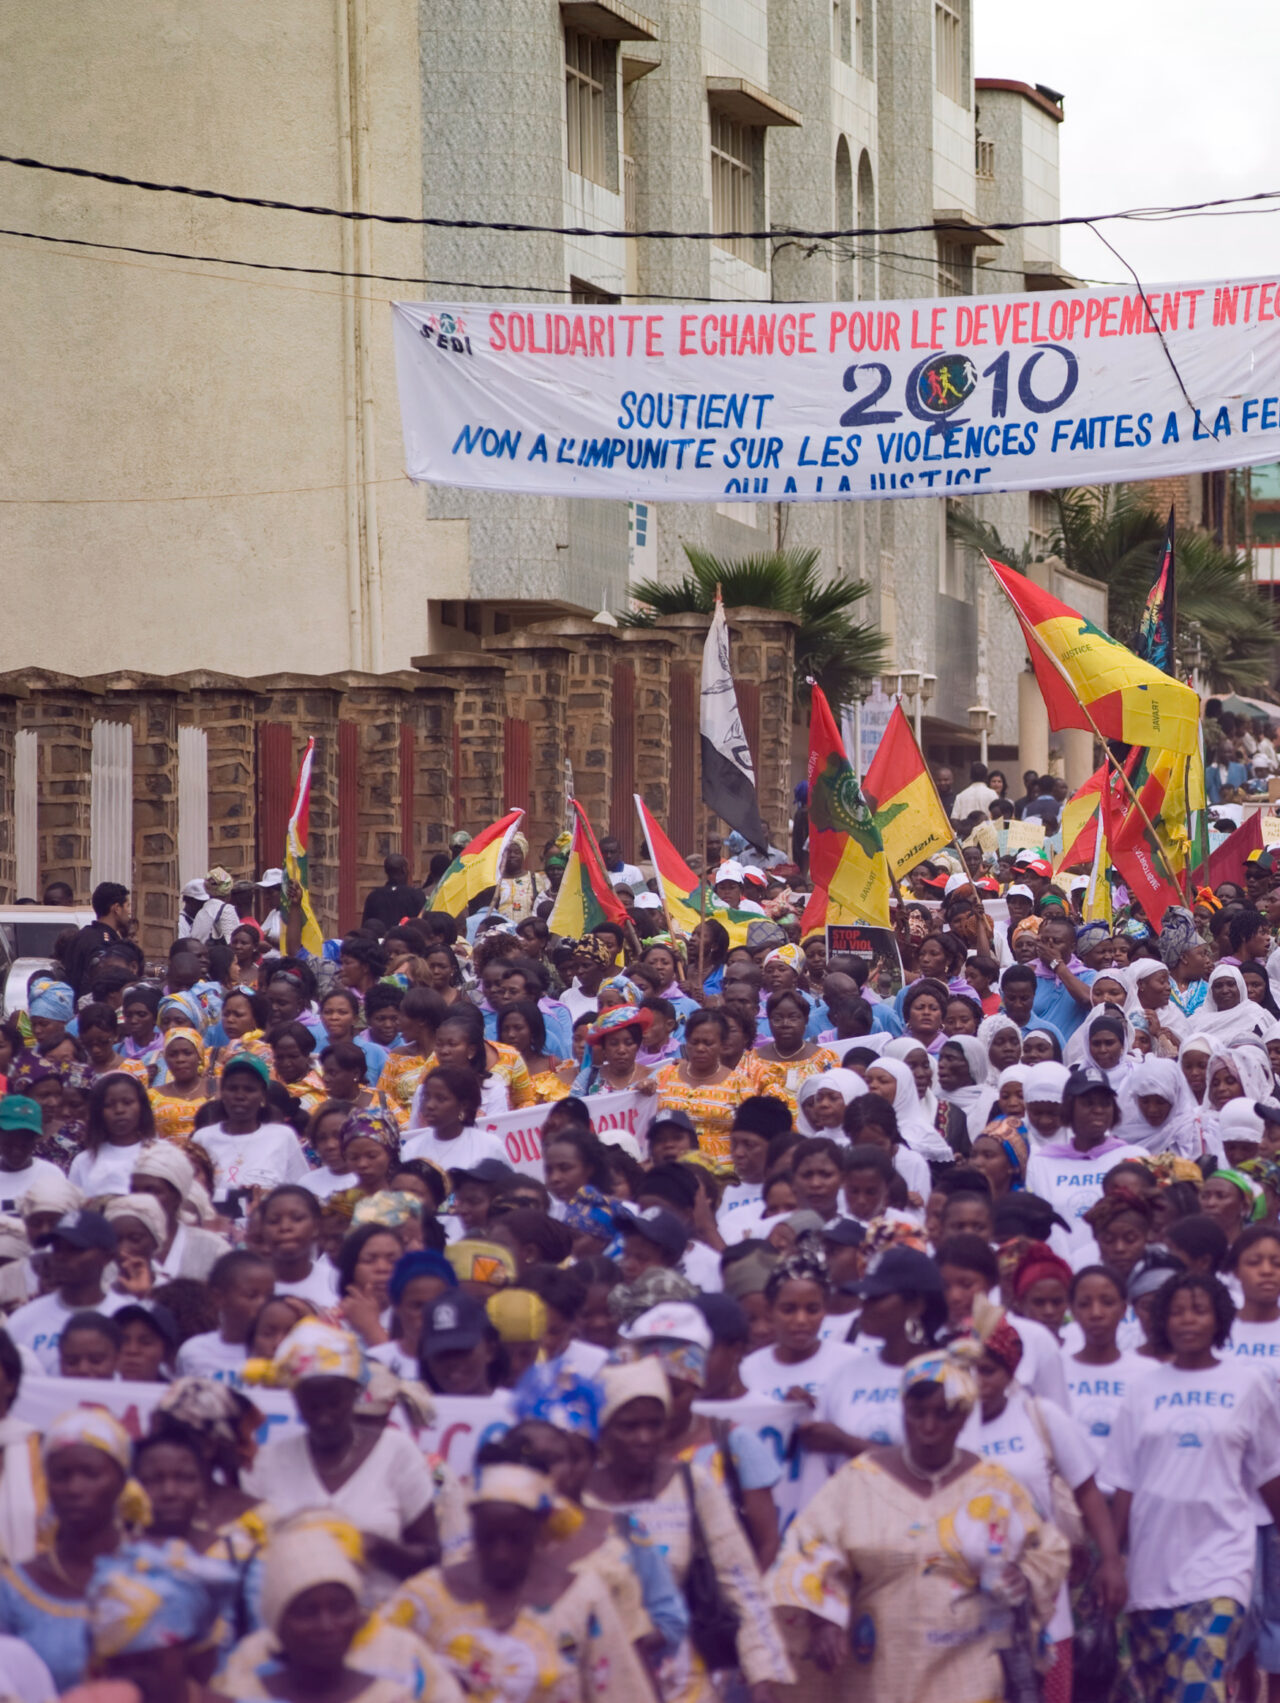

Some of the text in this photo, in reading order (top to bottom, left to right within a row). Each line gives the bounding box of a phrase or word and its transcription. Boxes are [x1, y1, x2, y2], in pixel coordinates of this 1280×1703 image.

[488, 311, 664, 357] SOLIDARITE
[680, 312, 817, 356] ECHANGE
[829, 310, 900, 352] POUR
[911, 307, 947, 349] LE
[956, 289, 1205, 346] DEVELOPPEMENT
[420, 324, 473, 356] SEDI
[617, 391, 774, 430] SOUTIENT
[452, 424, 522, 460] NON
[527, 433, 548, 463] A
[556, 437, 714, 470] L'IMPUNITE
[723, 439, 783, 470] SUR
[797, 434, 862, 468] LES
[877, 420, 1038, 464] VIOLENCES
[1050, 412, 1153, 453] FAITES
[1162, 416, 1180, 445] A
[1192, 405, 1232, 441] LA
[1062, 644, 1093, 661] JUSTICE
[832, 929, 860, 940] STOP
[832, 940, 873, 951] AU VIOL
[1056, 1172, 1104, 1187] PARE
[852, 1388, 900, 1405] PAR
[1153, 1390, 1235, 1411] PAREC
